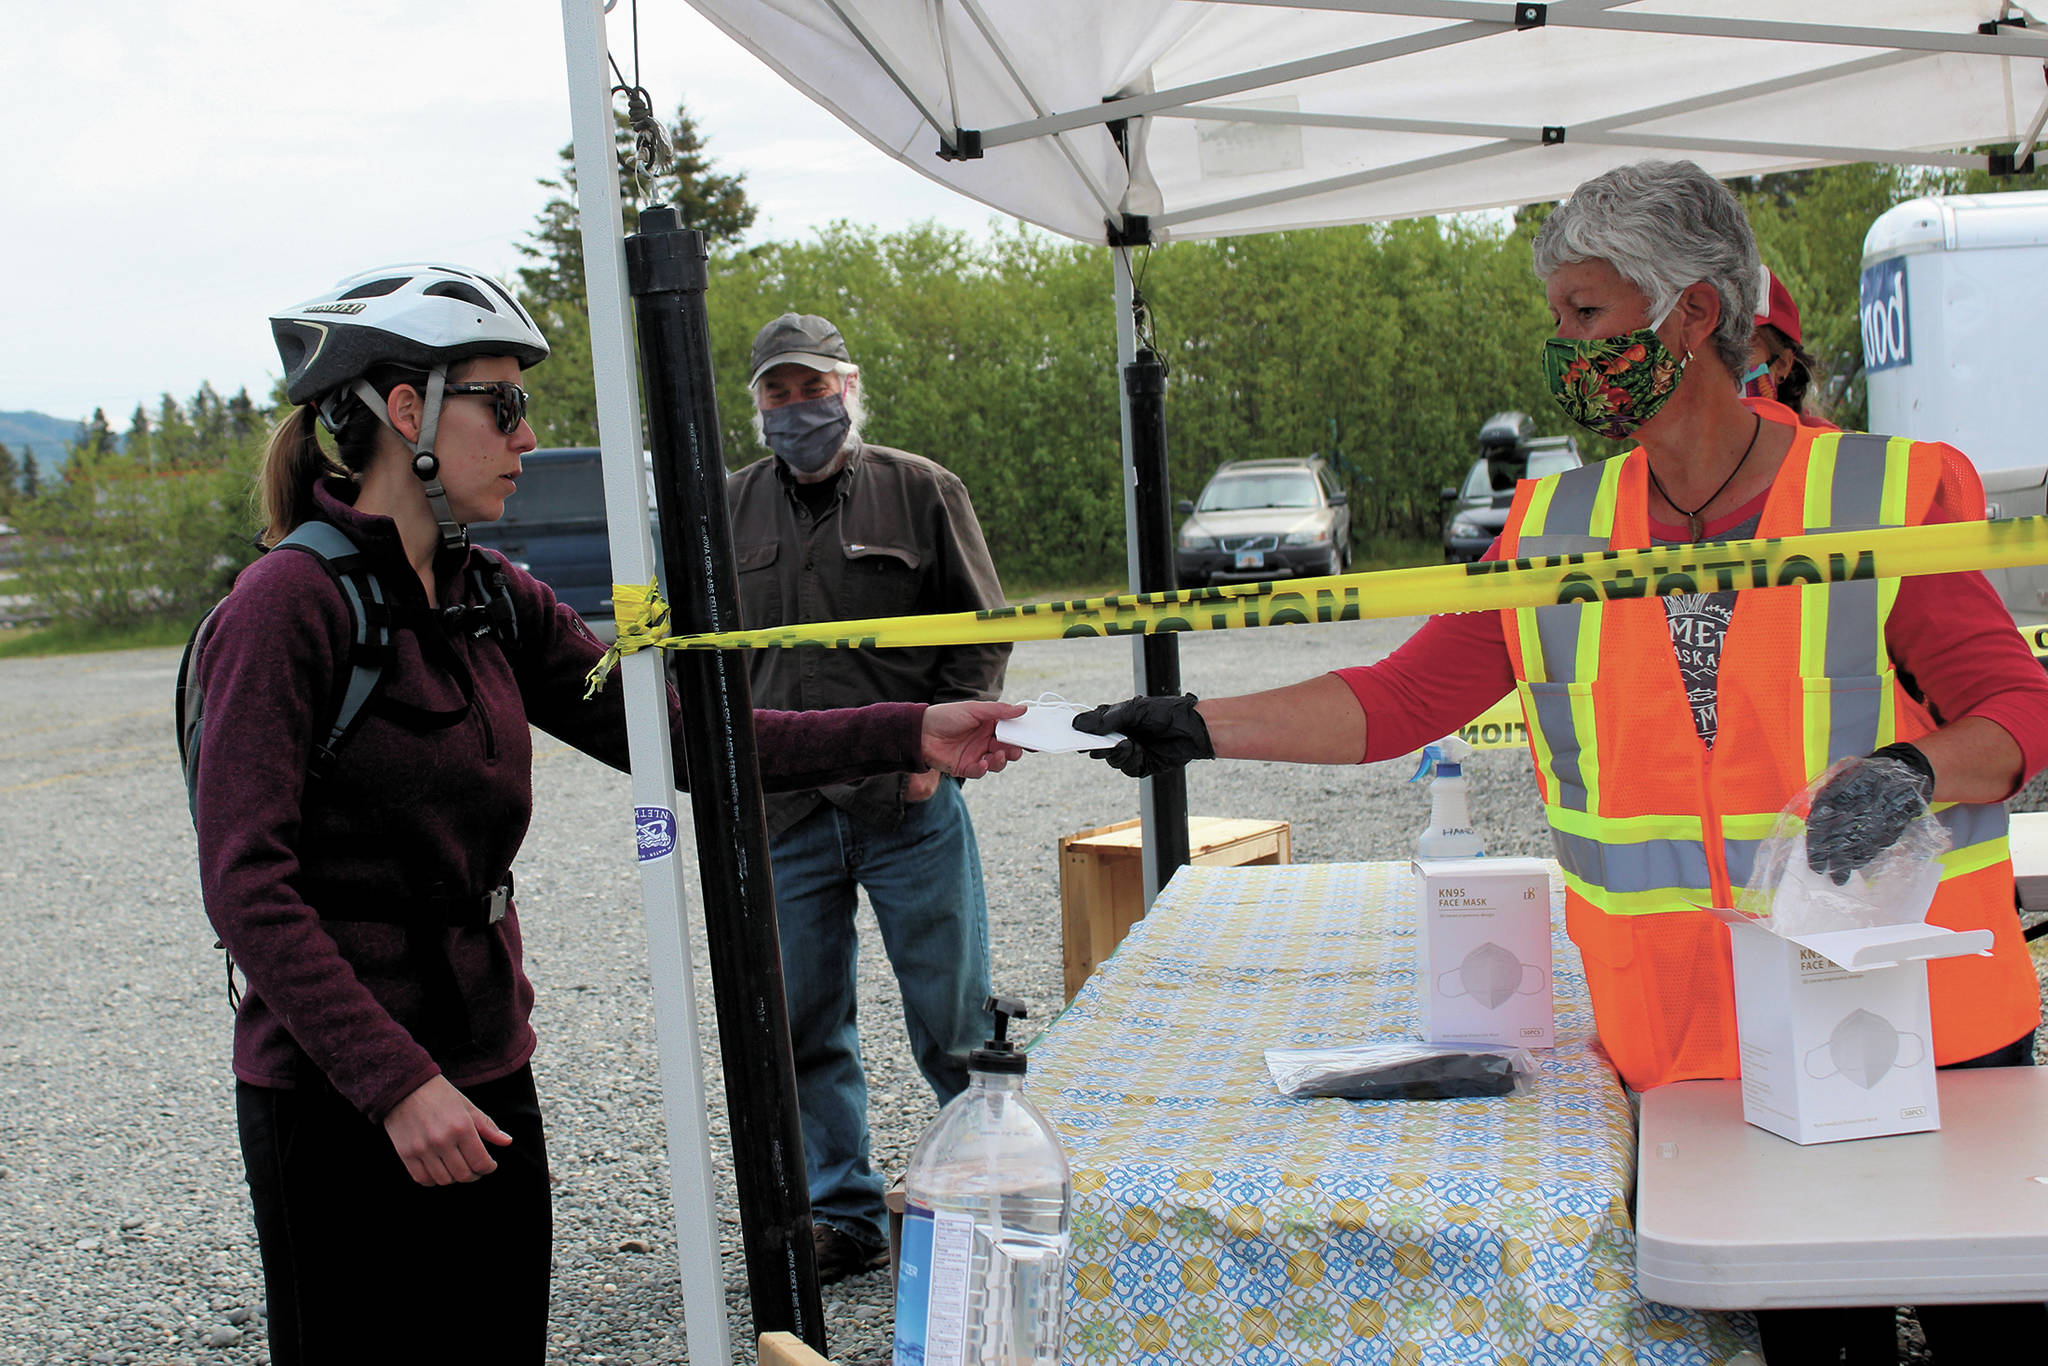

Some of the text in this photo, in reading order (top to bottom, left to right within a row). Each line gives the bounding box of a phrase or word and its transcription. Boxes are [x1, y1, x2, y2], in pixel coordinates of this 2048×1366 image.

[1438, 888, 1466, 898] KN95
[1439, 898, 1487, 907] FACE MASK
[1801, 960, 1823, 970] FACE
